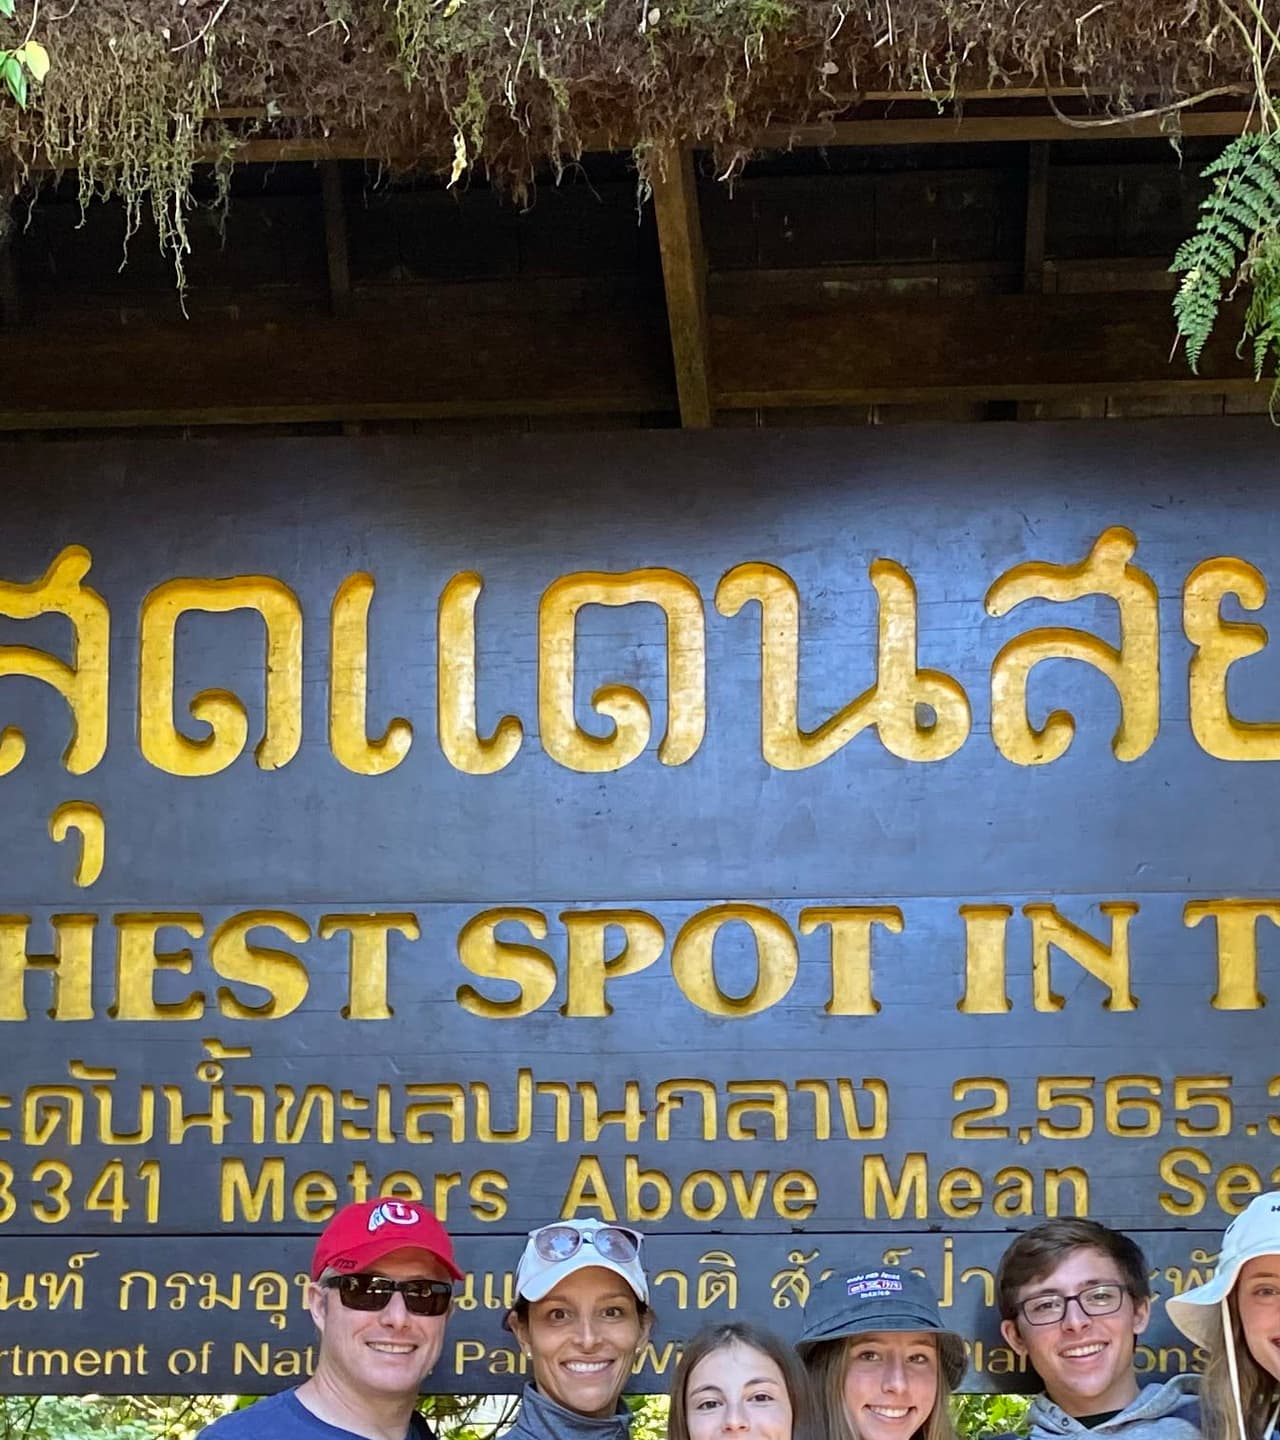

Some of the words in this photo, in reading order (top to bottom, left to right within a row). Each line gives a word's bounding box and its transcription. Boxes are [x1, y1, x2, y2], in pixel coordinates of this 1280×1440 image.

[457, 903, 904, 1019] SPOT
[958, 902, 1139, 1014] IN
[219, 1156, 509, 1223] Meters
[561, 1156, 818, 1222] Above
[862, 1152, 1090, 1219] Mean
[167, 1341, 215, 1376] of
[455, 1341, 528, 1375] Par
